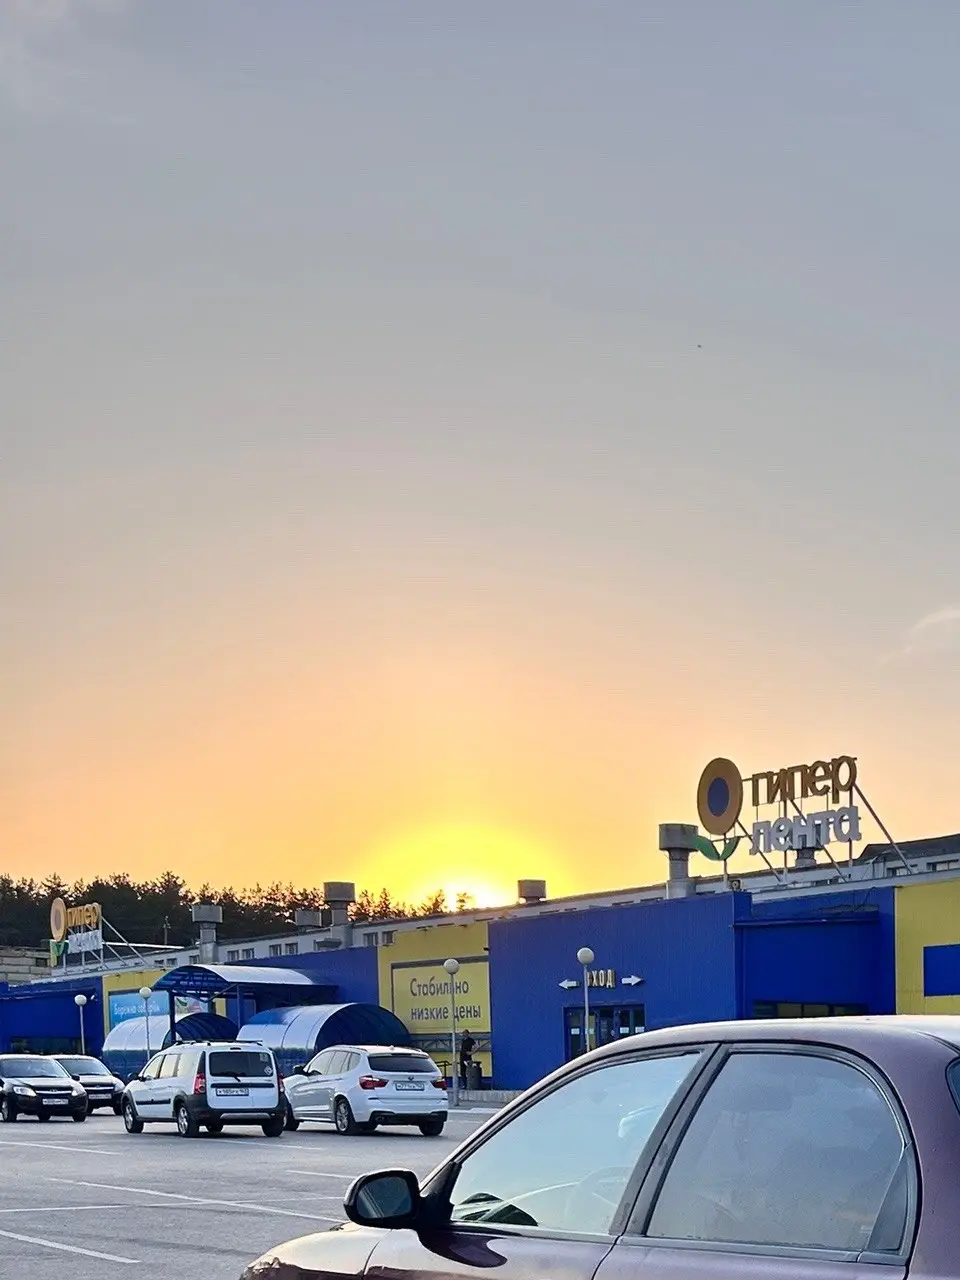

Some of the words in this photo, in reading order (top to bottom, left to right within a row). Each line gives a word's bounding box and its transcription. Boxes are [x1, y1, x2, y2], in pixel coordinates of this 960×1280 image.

[752, 755, 856, 806] гипер
[749, 806, 862, 855] лента
[409, 976, 469, 997] Стабилно
[410, 1006, 449, 1021] низкие
